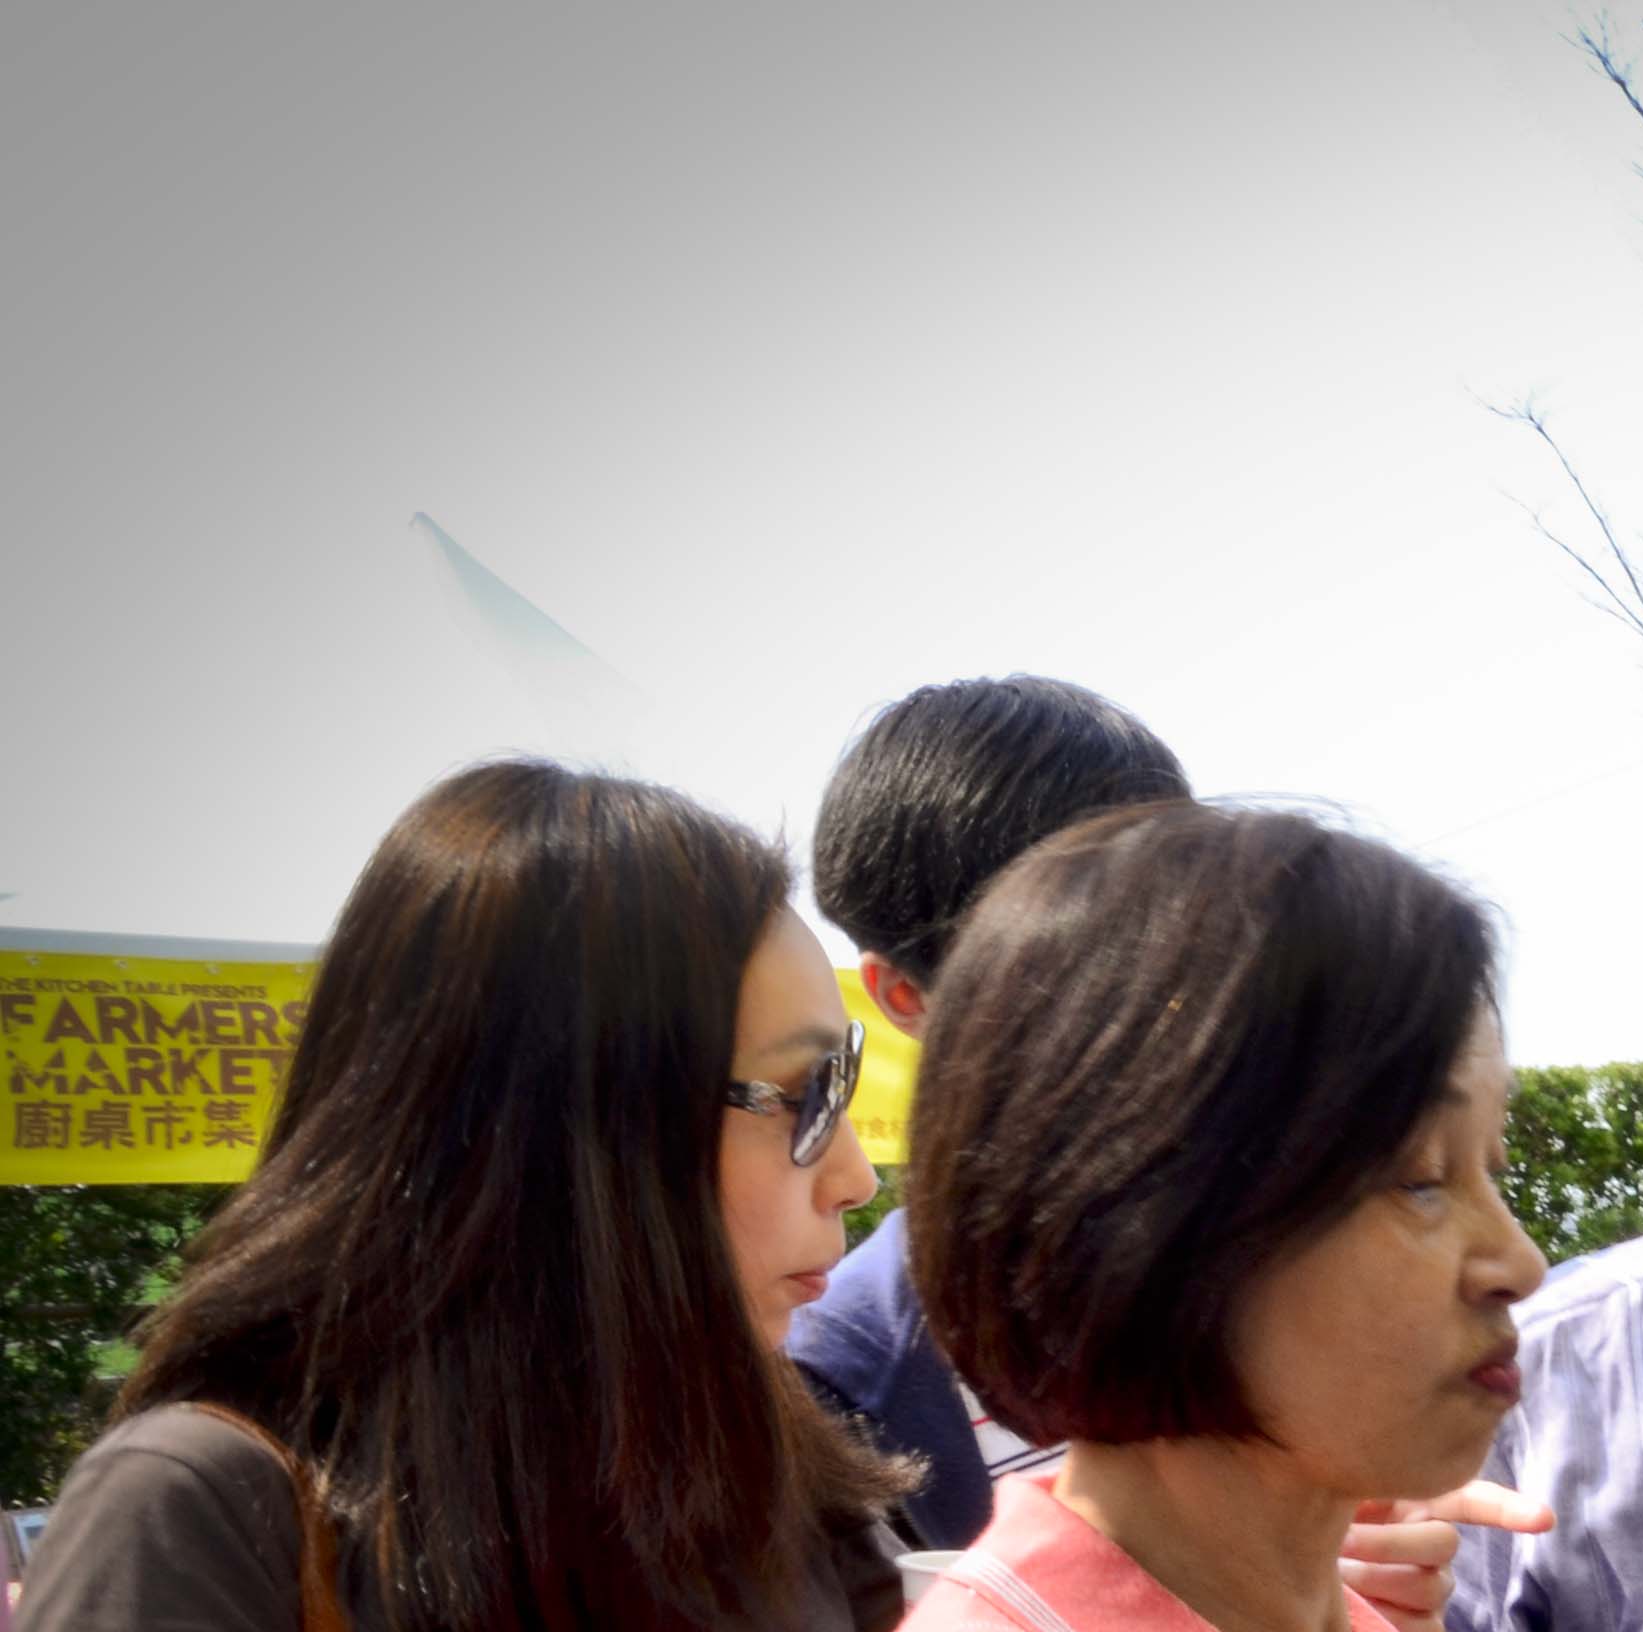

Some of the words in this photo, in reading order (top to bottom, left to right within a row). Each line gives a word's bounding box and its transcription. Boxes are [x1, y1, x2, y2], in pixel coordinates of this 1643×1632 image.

[34, 979, 118, 994] KITCHEN
[124, 980, 178, 996] TABLE
[180, 983, 267, 999] PRESENTS
[0, 994, 309, 1046] FARMERS
[5, 1047, 296, 1096] MARKET
[13, 1099, 257, 1150] 廚桌市集
